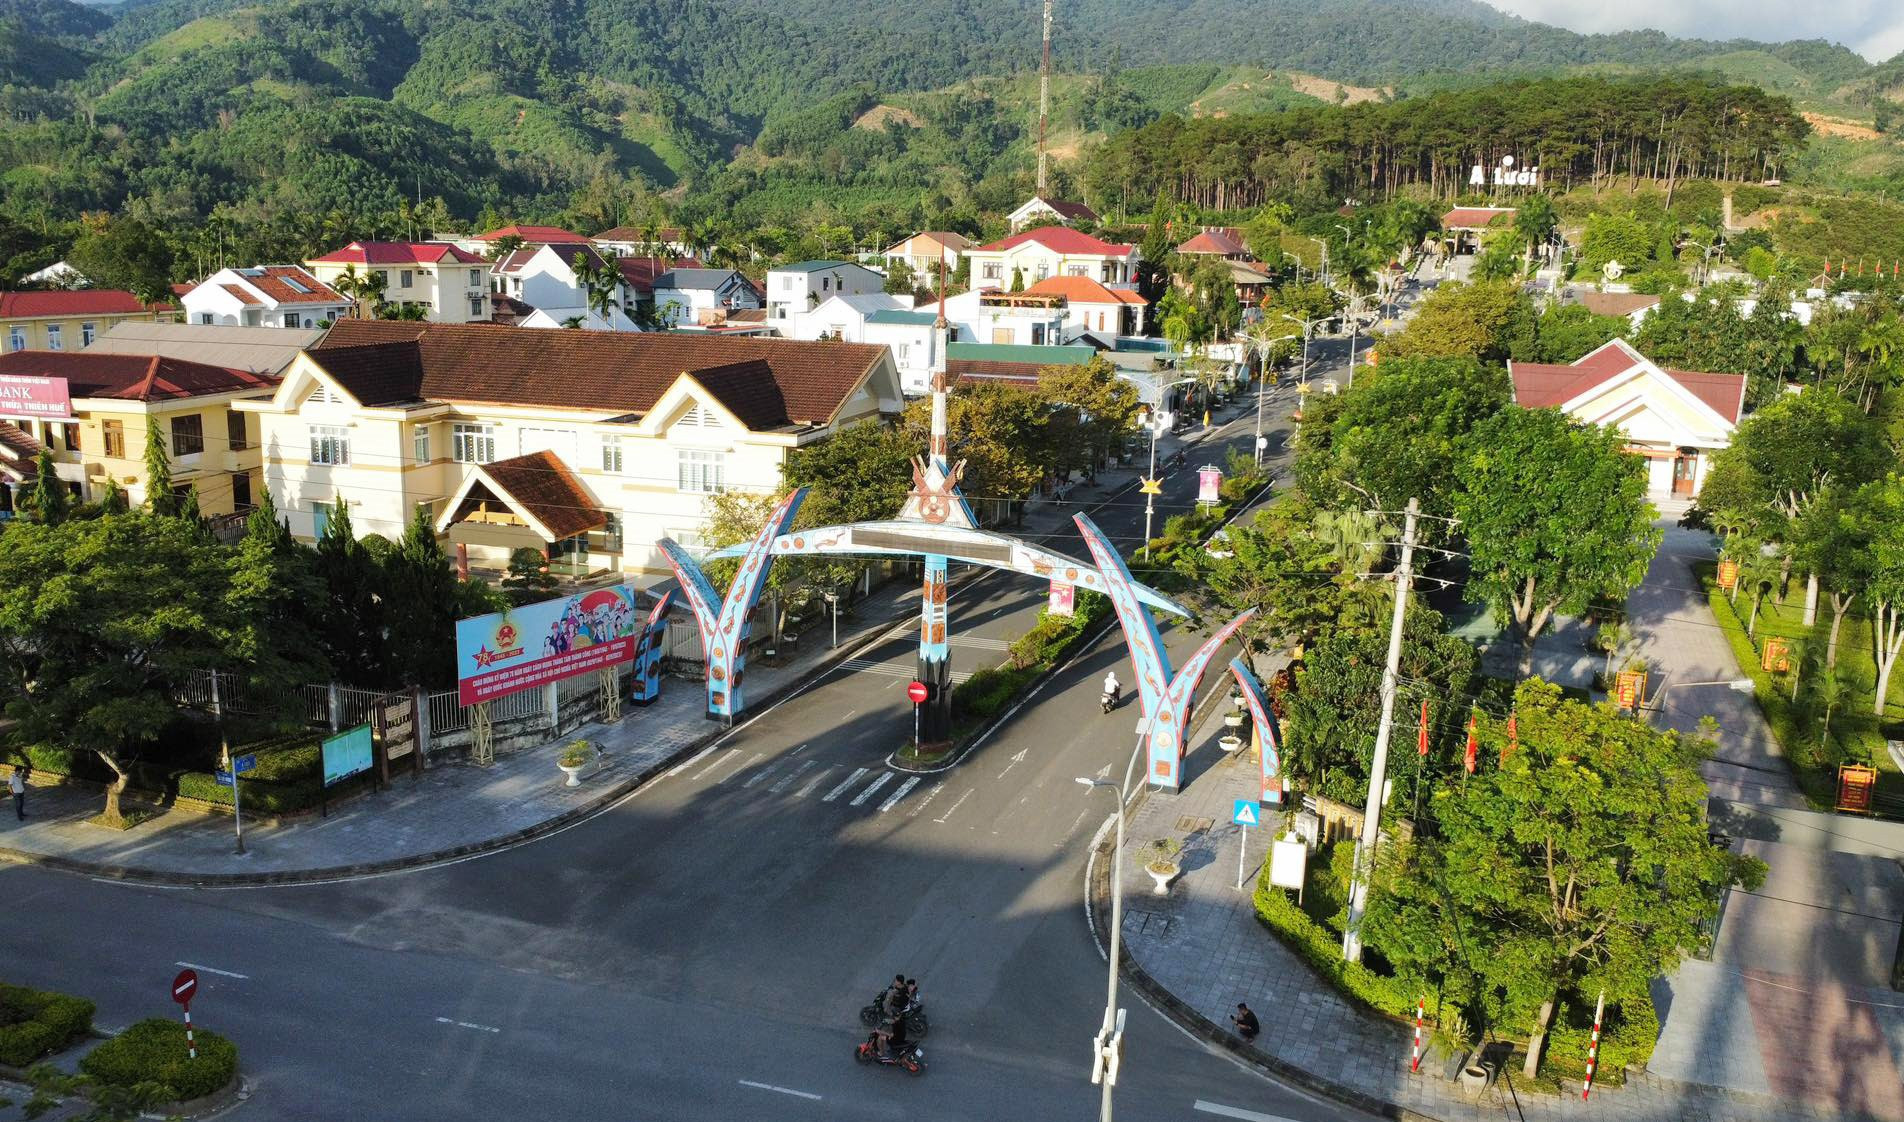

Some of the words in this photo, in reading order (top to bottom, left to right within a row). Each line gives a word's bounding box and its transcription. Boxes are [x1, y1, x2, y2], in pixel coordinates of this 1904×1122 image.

[1469, 165, 1484, 184] A
[1494, 166, 1538, 185] Lưới
[48, 401, 65, 412] HUẾ
[477, 653, 488, 664] 78
